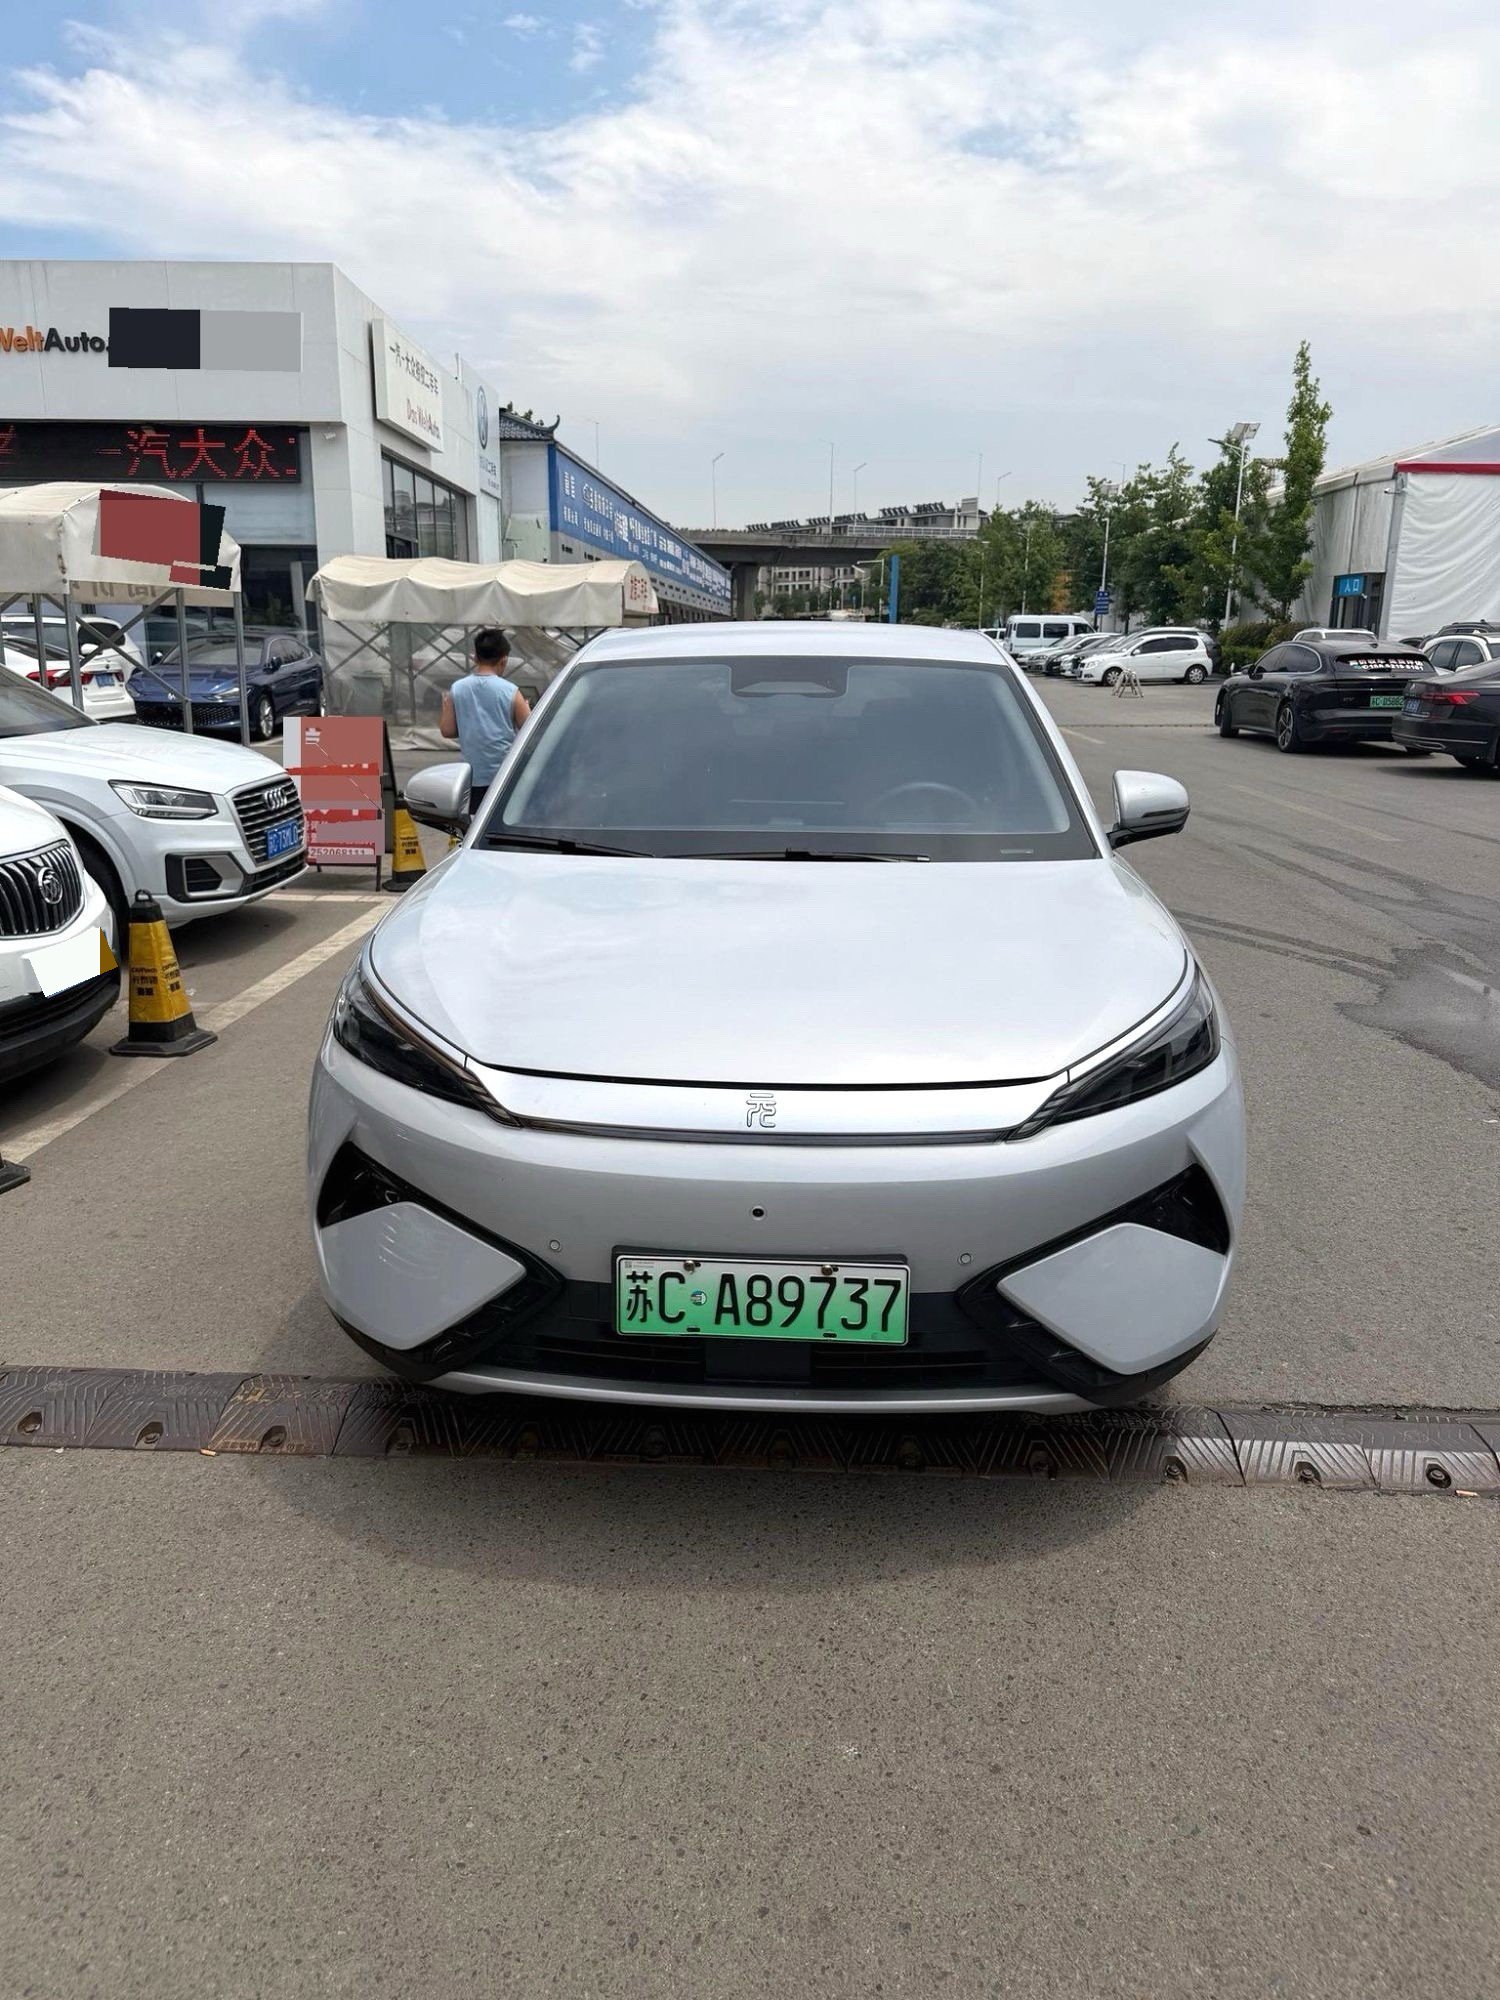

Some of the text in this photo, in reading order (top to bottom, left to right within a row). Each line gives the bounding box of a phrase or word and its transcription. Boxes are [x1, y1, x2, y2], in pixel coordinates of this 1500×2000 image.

[97, 427, 296, 480] 一汽大众
[1343, 578, 1361, 593] 入口
